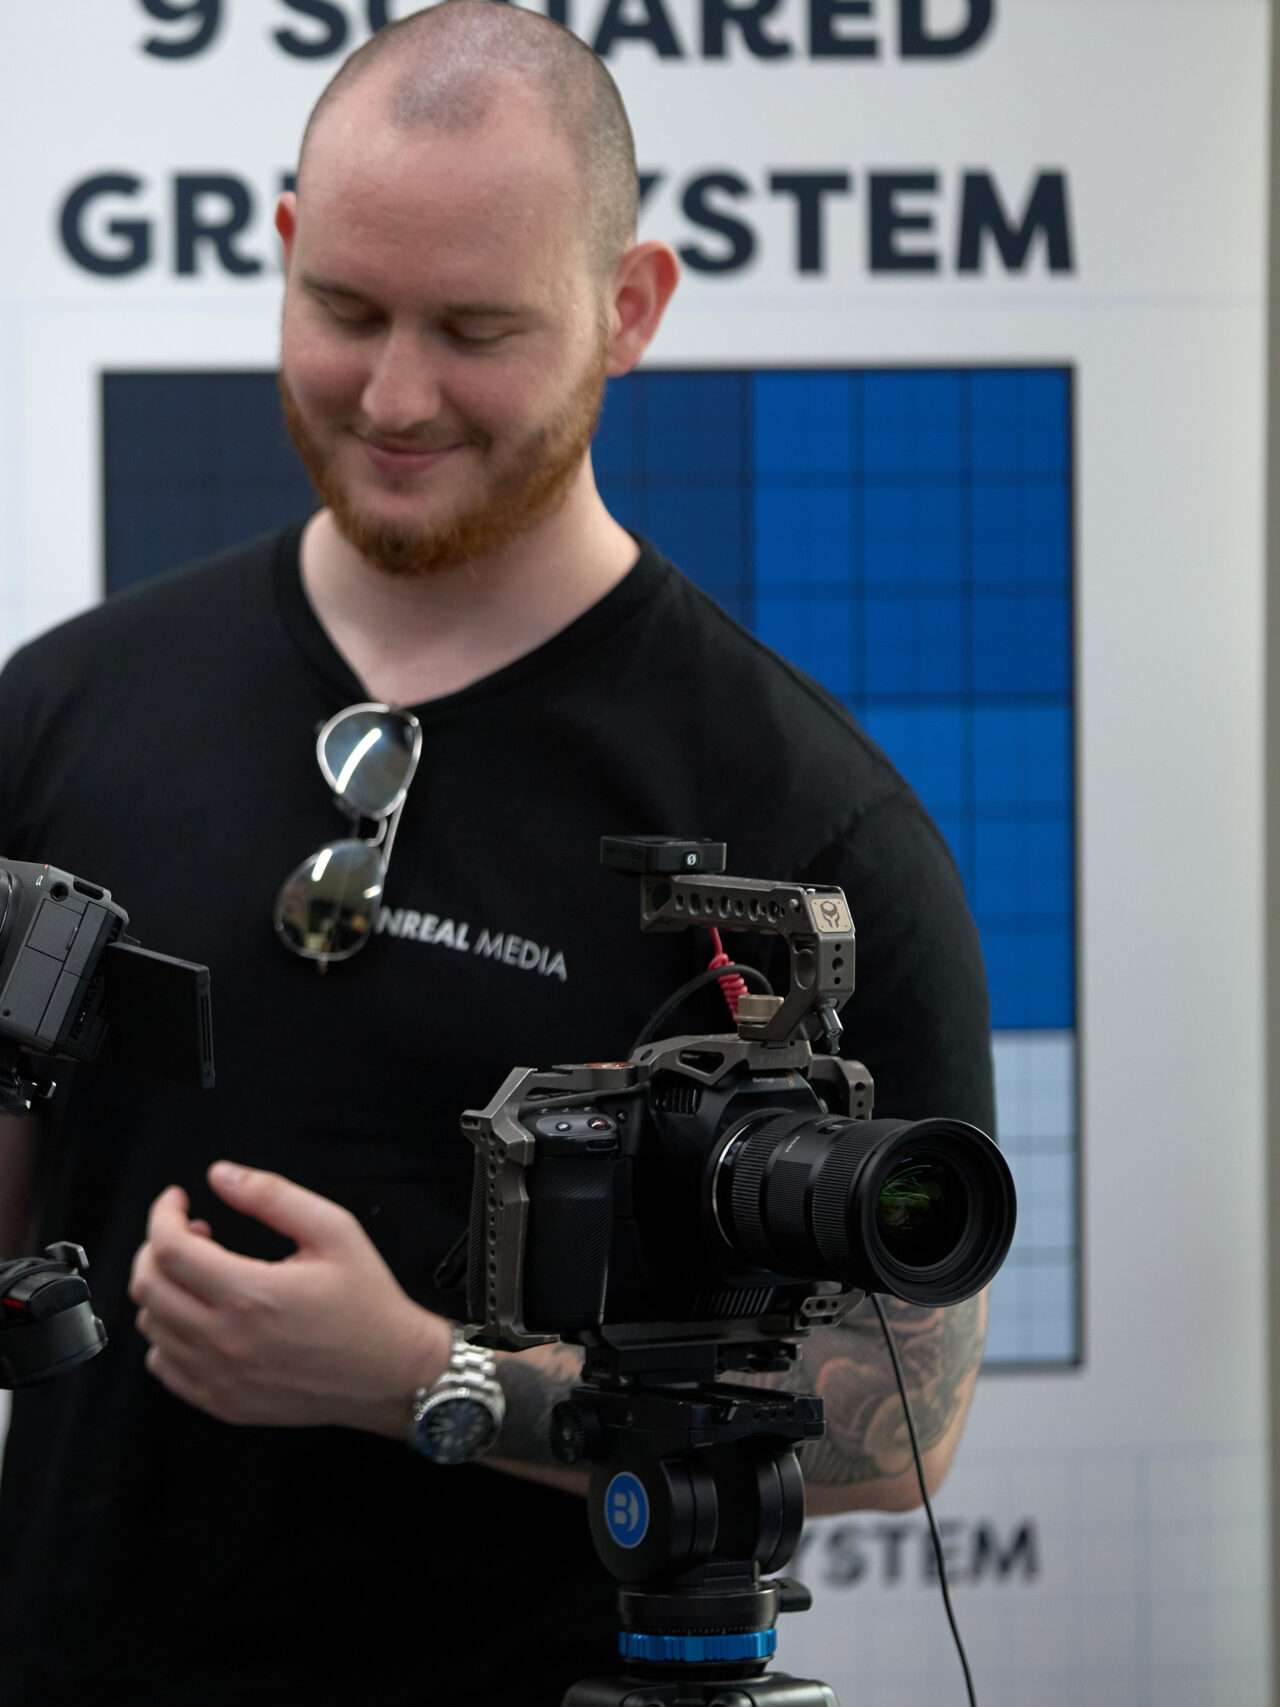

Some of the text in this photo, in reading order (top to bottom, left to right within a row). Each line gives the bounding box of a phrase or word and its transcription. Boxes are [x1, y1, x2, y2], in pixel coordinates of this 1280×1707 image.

[272, 0, 996, 59] SARED
[60, 168, 1074, 276] GR STEM
[375, 906, 568, 983] NREAL MEDIA
[788, 1519, 1039, 1588] STEM
